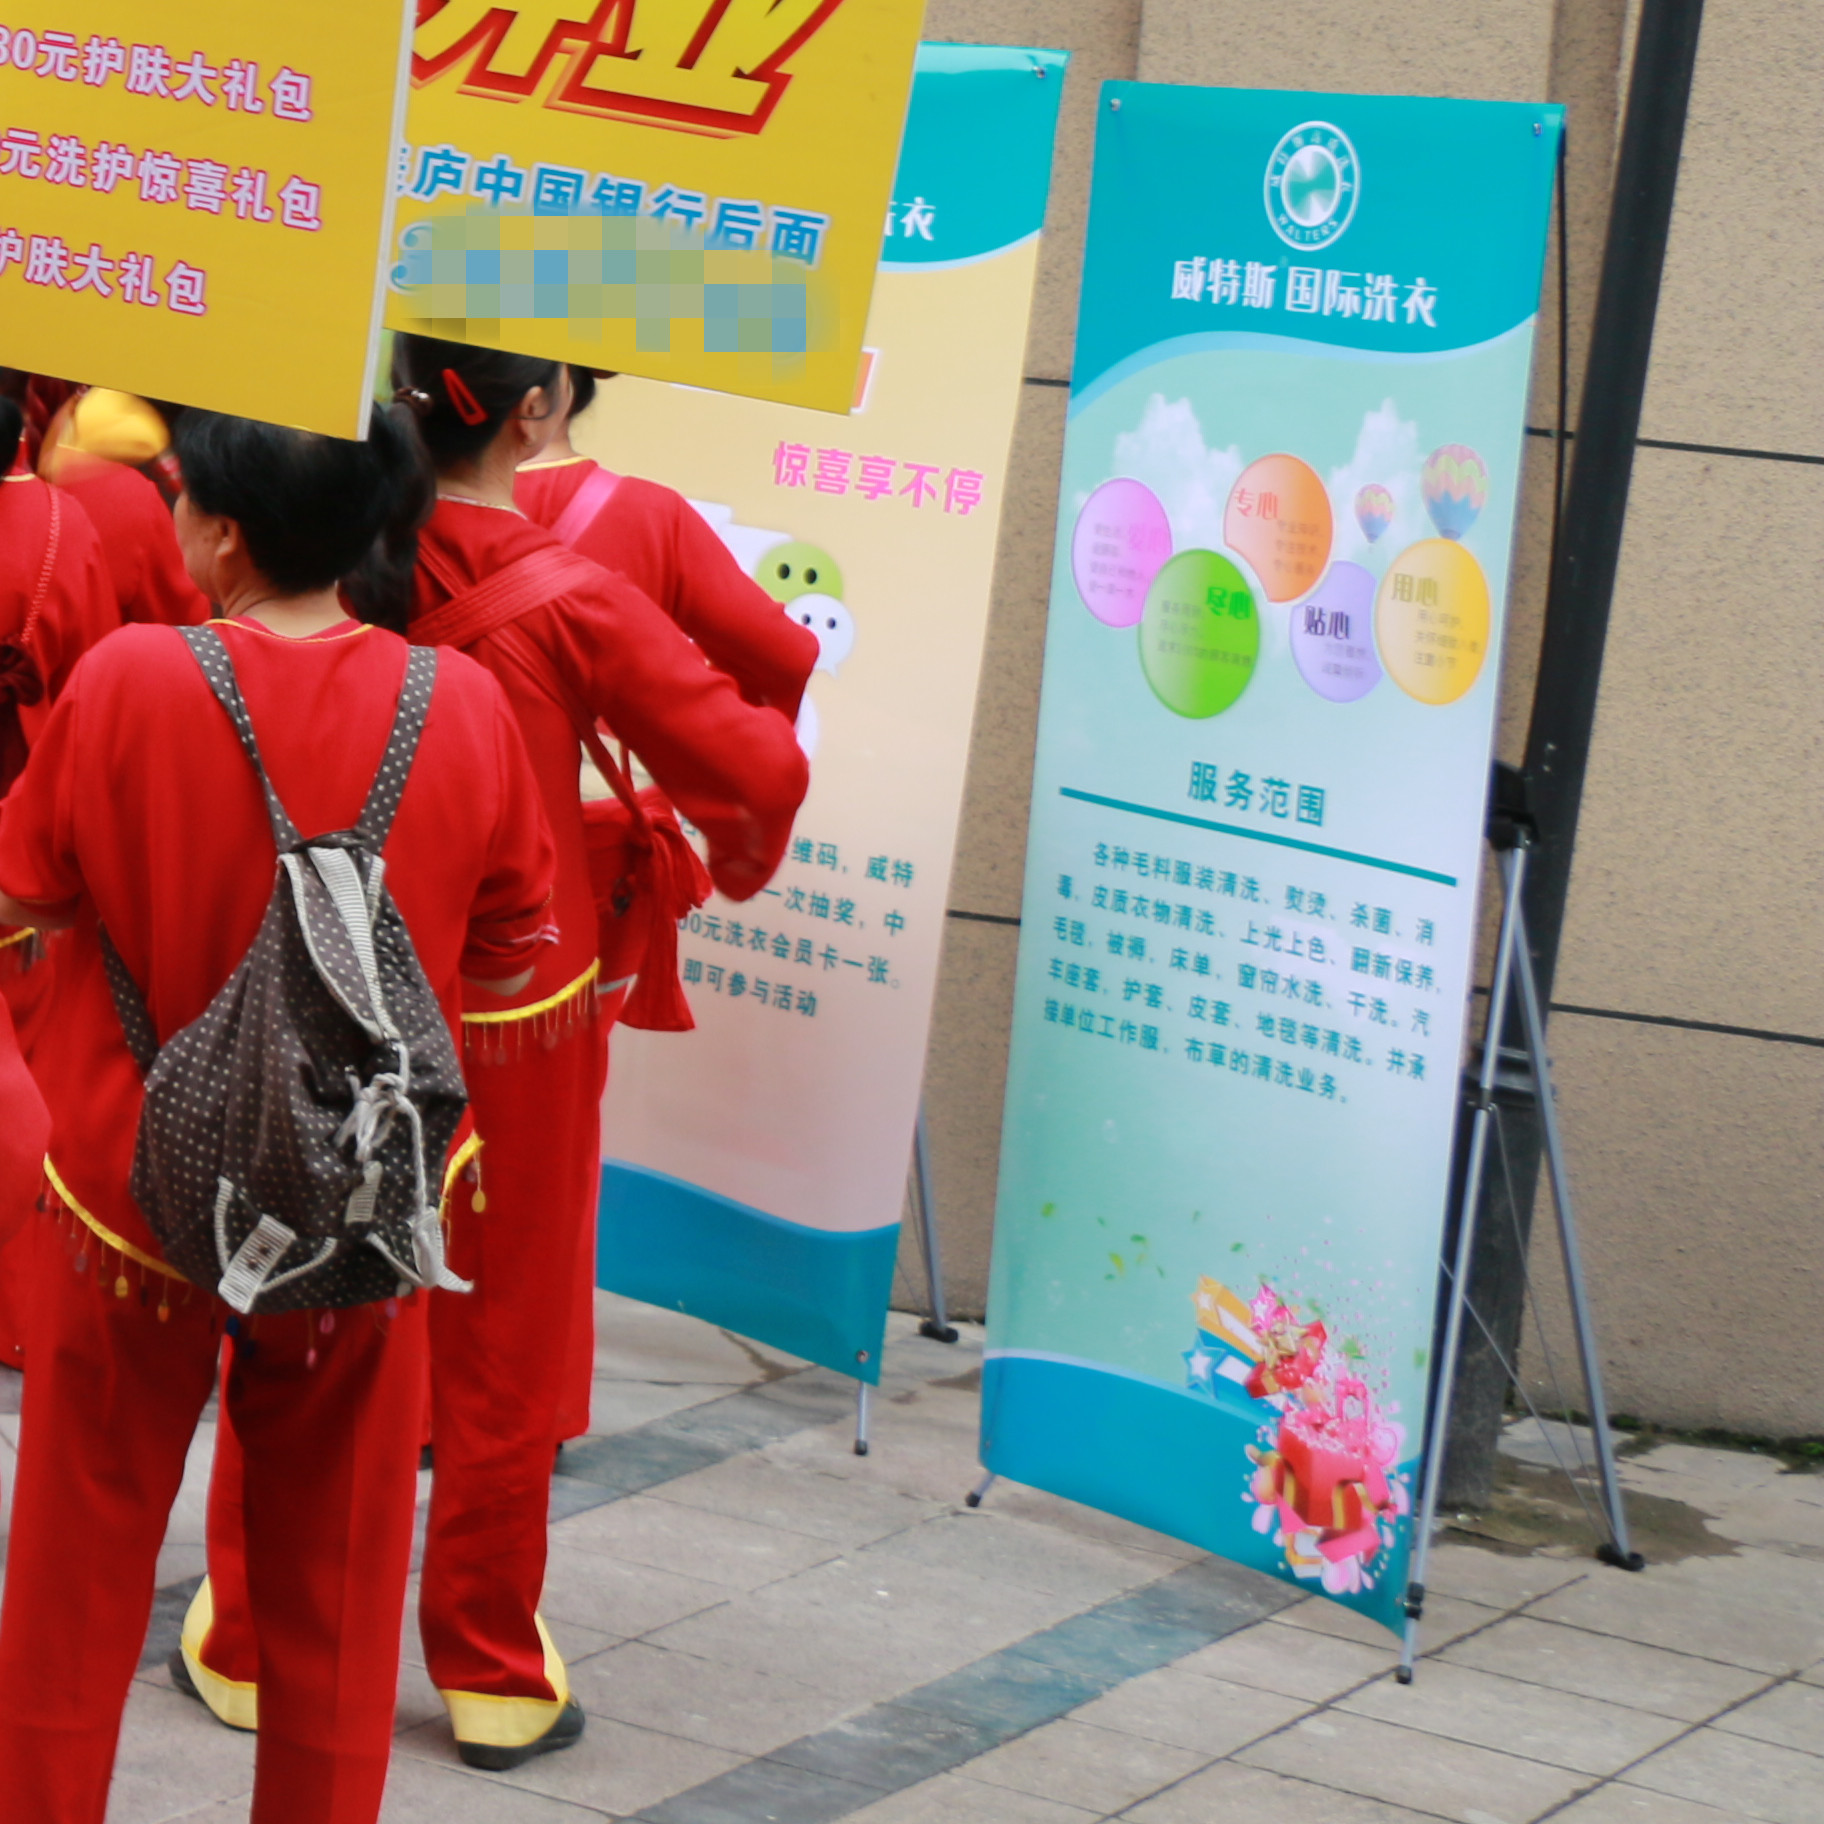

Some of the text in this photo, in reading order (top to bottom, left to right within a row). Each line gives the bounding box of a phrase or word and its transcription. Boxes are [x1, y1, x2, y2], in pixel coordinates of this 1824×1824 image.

[398, 142, 831, 269] 庐中国银行后面
[772, 440, 985, 518] 惊喜享不停
[1234, 488, 1279, 521] 专心
[1304, 605, 1352, 640] 贴心
[1186, 761, 1326, 827] 服务范围
[682, 958, 819, 1018] 即可参与活动
